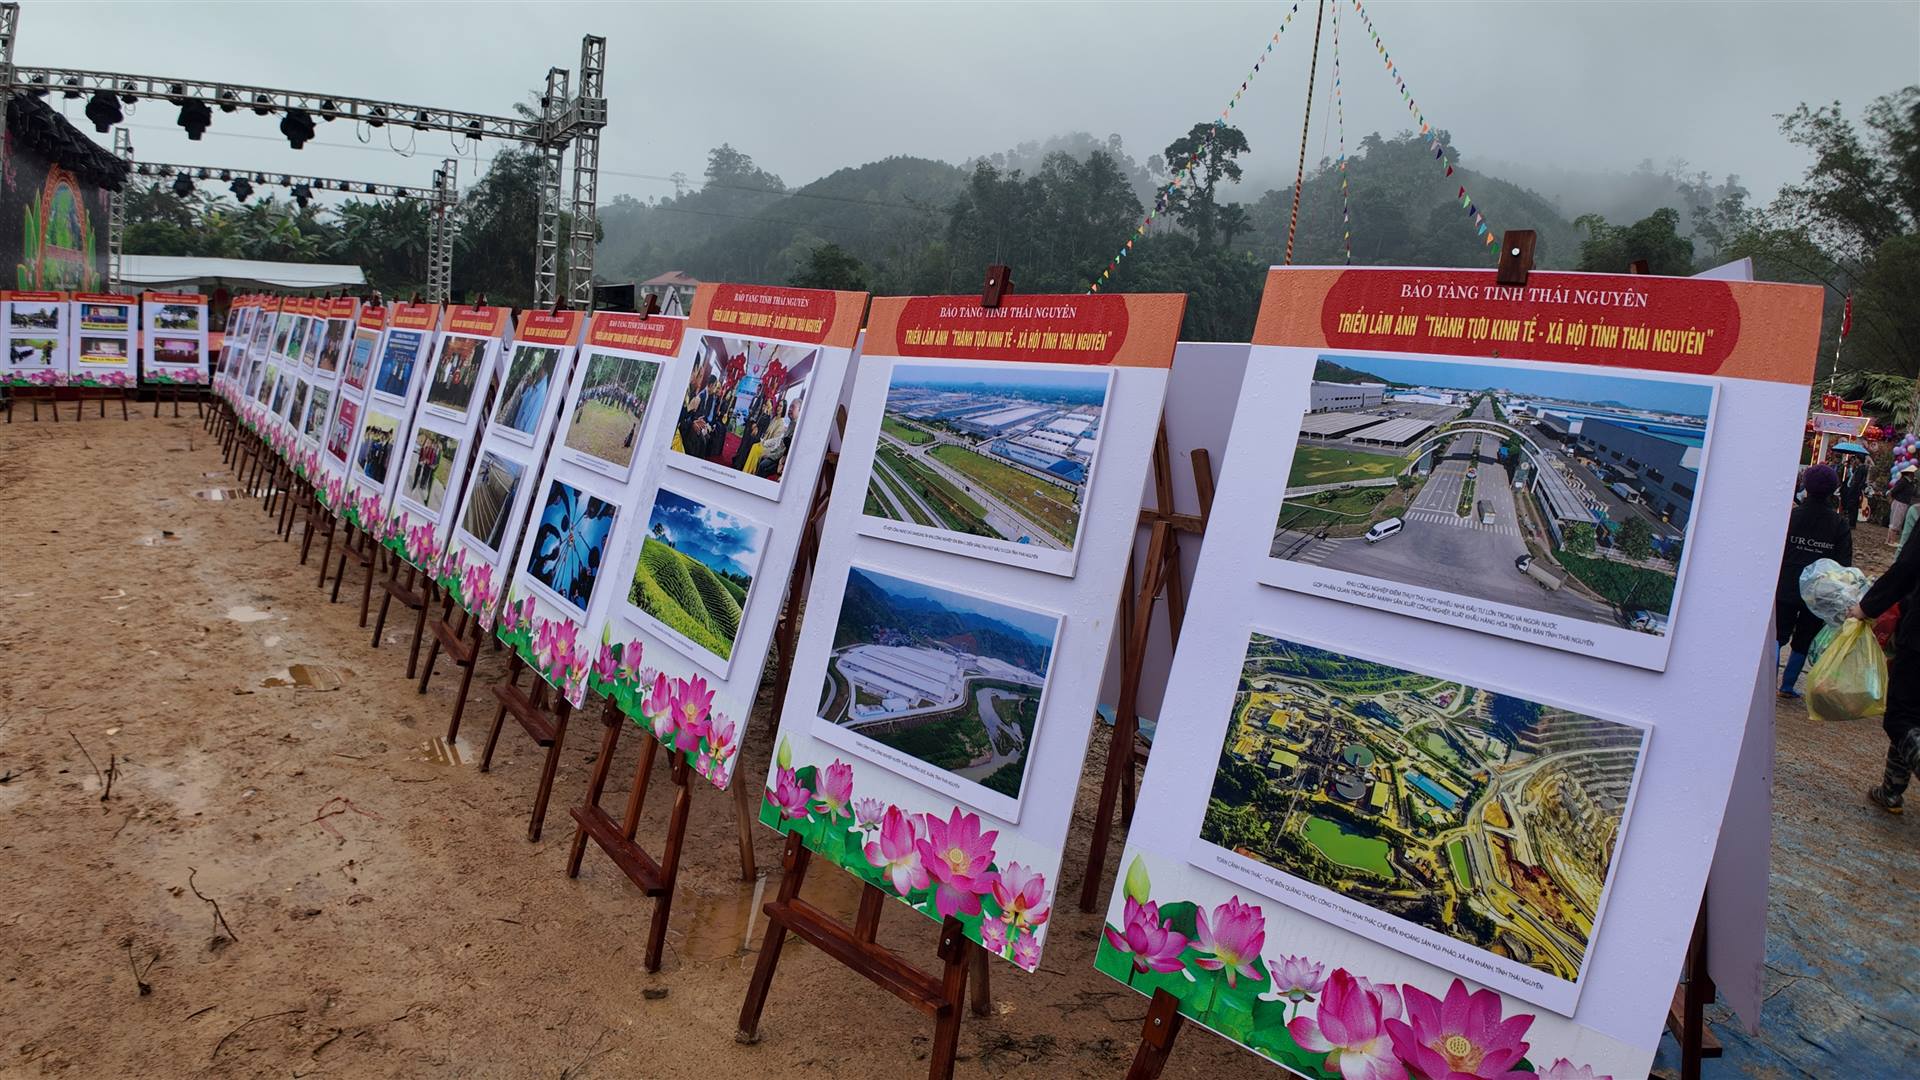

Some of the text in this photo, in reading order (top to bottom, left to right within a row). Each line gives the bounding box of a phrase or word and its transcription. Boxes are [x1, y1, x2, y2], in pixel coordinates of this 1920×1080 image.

[1401, 279, 1433, 298] BẢO
[1437, 281, 1479, 300] TÀNG
[1528, 284, 1570, 304] THÁI
[1573, 287, 1648, 308] NGUYÊN
[939, 303, 958, 318] BẢO
[959, 304, 984, 318] TÀNG
[1010, 303, 1034, 318] THÁI
[1034, 303, 1077, 318] NGUYÊN
[1337, 305, 1369, 334] TRIỂN
[1369, 310, 1394, 335] LÃM
[1393, 306, 1419, 336] ẢNH
[1467, 316, 1490, 344] TỰU
[1490, 319, 1521, 341] KINH
[1522, 313, 1540, 343] TẾ
[1545, 319, 1564, 344] XÃ
[1565, 319, 1588, 351] HỘI
[1590, 316, 1619, 348] TỈNH
[1621, 322, 1651, 351] THÁI
